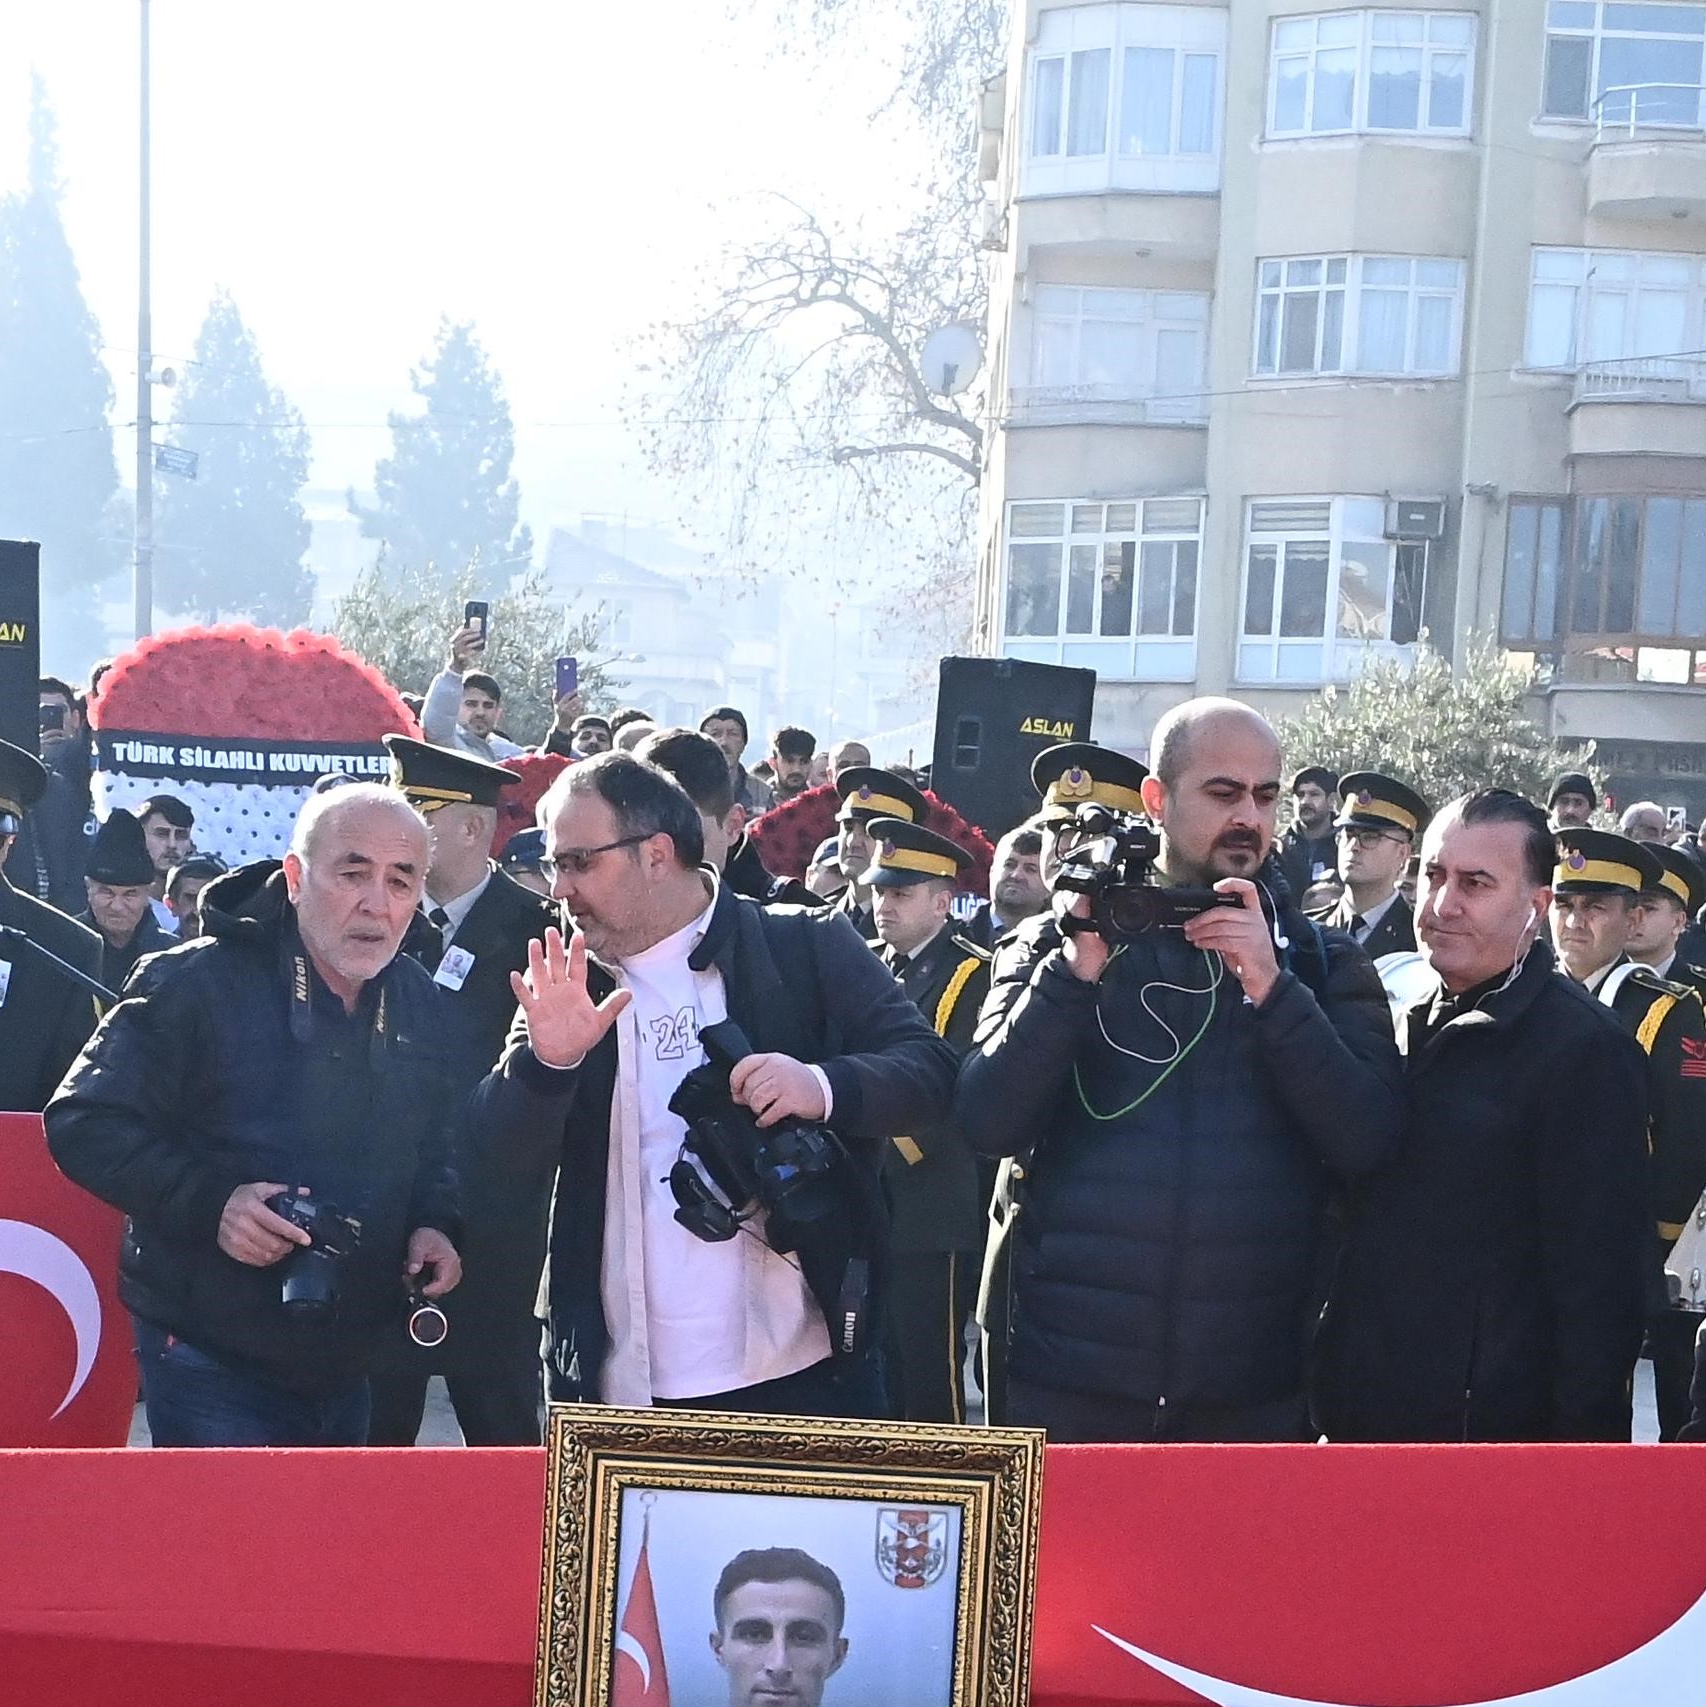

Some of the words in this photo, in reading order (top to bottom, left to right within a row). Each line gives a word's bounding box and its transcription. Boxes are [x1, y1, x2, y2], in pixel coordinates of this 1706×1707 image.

[1020, 716, 1074, 739] ASLAN
[112, 740, 175, 765] TÜRK
[179, 745, 265, 771] SİLAHLI
[294, 955, 307, 1002] Nikon
[649, 1005, 701, 1061] 24
[842, 1311, 856, 1353] Canon
